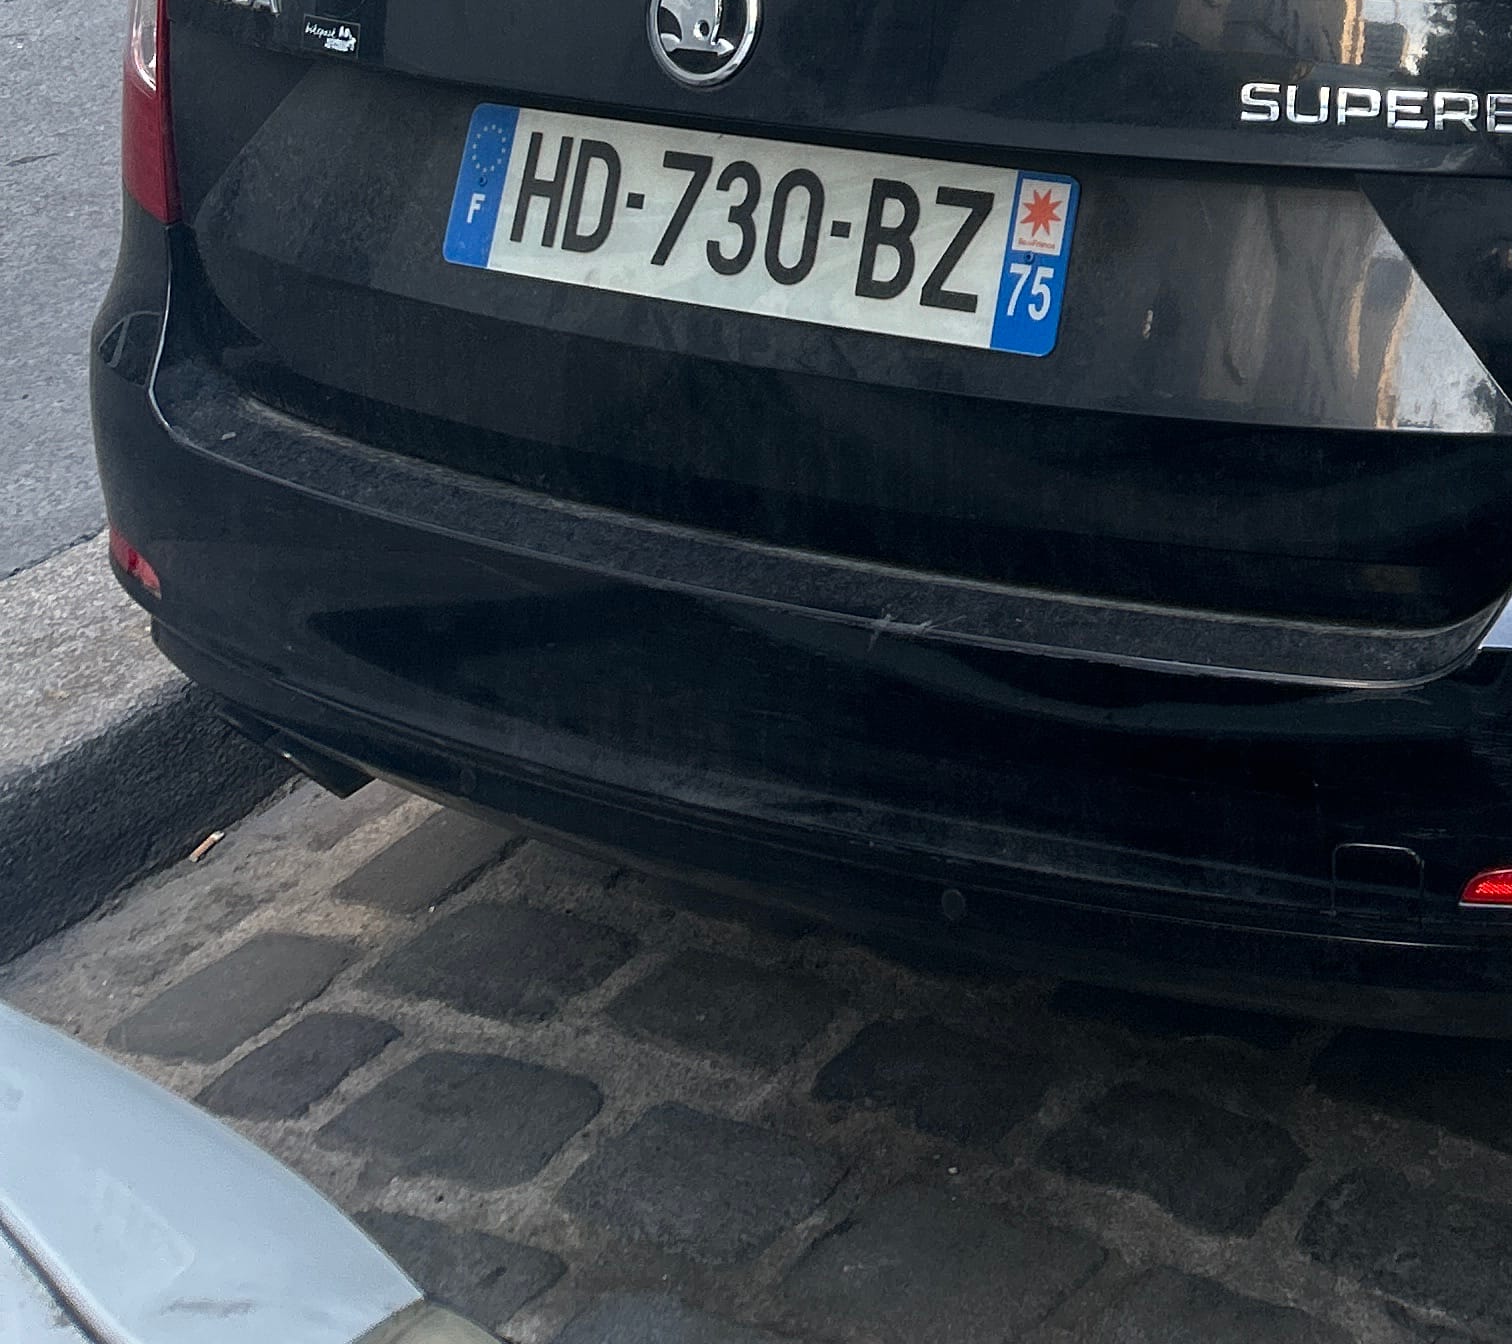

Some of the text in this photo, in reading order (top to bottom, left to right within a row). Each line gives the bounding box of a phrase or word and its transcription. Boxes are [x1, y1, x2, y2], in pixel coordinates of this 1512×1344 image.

[465, 193, 486, 224] F
[509, 131, 996, 314] HD-730-BZ
[1006, 263, 1055, 321] 75
